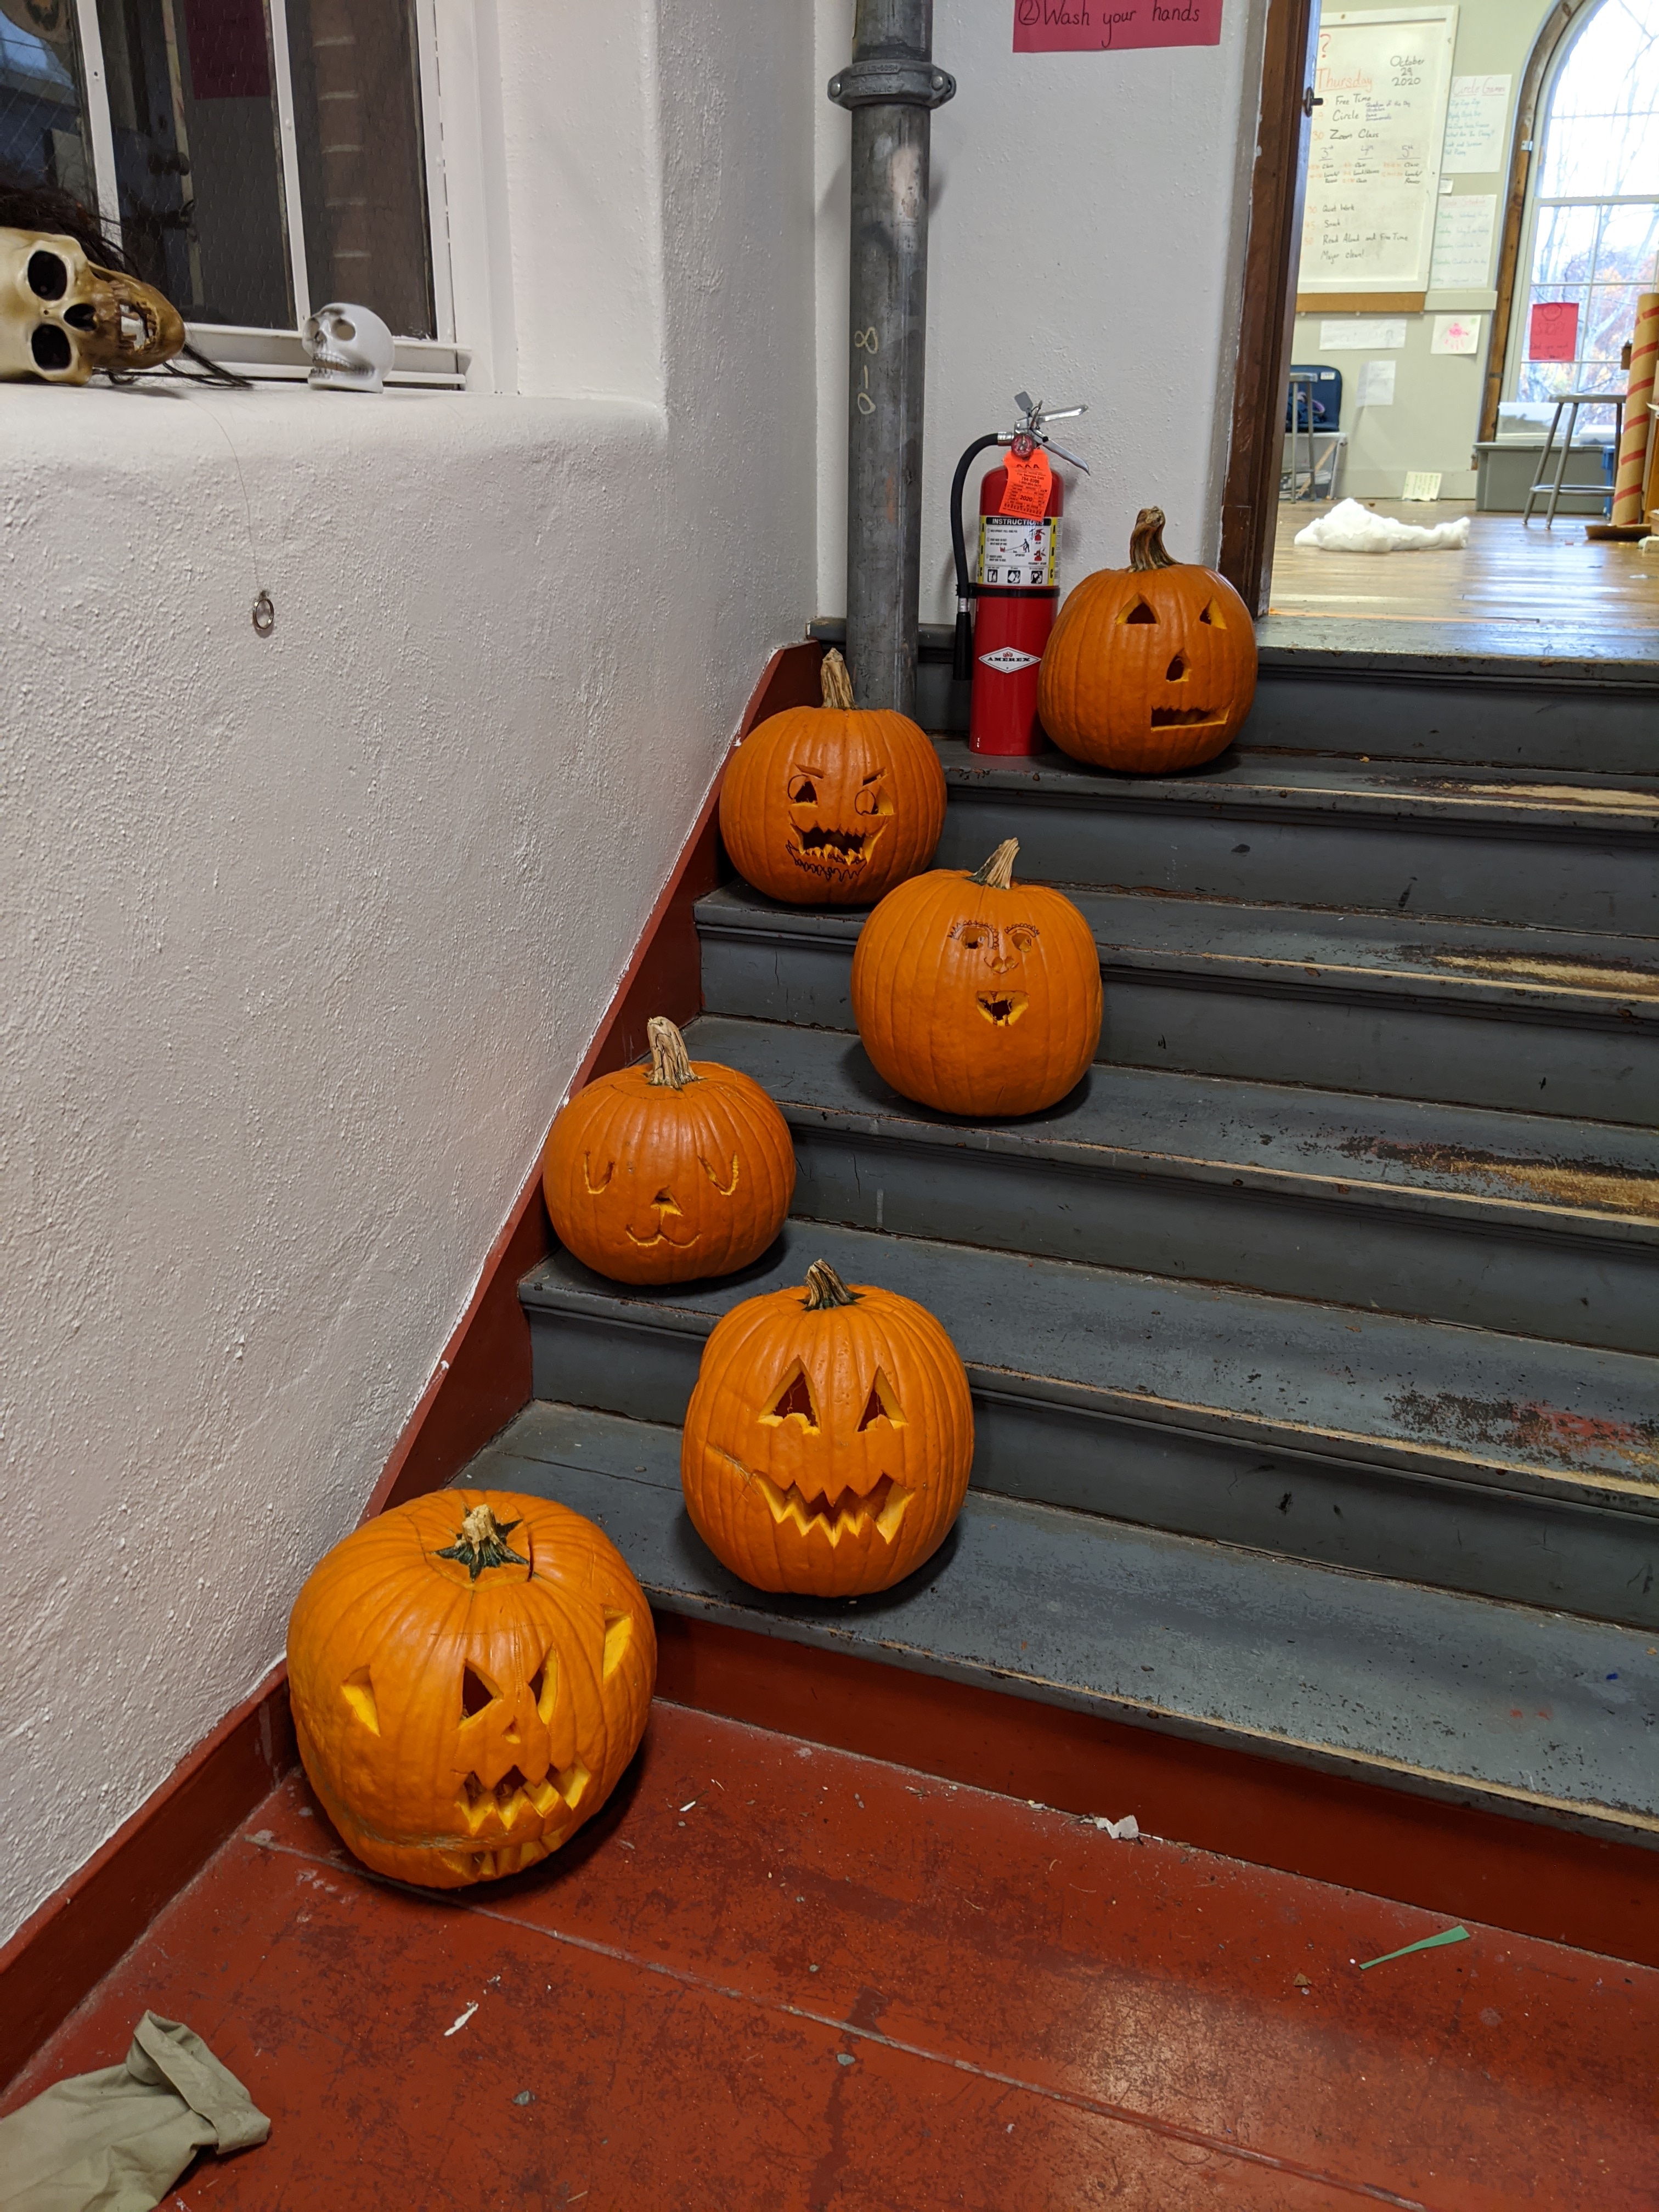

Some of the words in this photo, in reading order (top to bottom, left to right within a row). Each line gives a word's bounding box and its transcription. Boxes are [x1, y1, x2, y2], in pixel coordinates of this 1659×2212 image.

[1044, 0, 1090, 25] Wash
[1102, 10, 1137, 48] your
[1152, 0, 1200, 22] hands
[1319, 33, 1331, 58] ?
[1390, 55, 1425, 67] October
[1400, 67, 1413, 76] 29
[1317, 68, 1372, 93] Thursday
[1391, 77, 1421, 86] 2020
[1335, 95, 1350, 106] Free
[1353, 93, 1372, 103] Time
[1333, 109, 1359, 121] Circle
[1330, 129, 1352, 139] Zoom
[1358, 128, 1379, 138] Class
[1402, 145, 1414, 157] 5th
[1323, 234, 1339, 245] Read
[1343, 233, 1359, 243] Aloud
[1365, 233, 1376, 241] and
[1052, 524, 1056, 534] A
[1050, 569, 1053, 578] C
